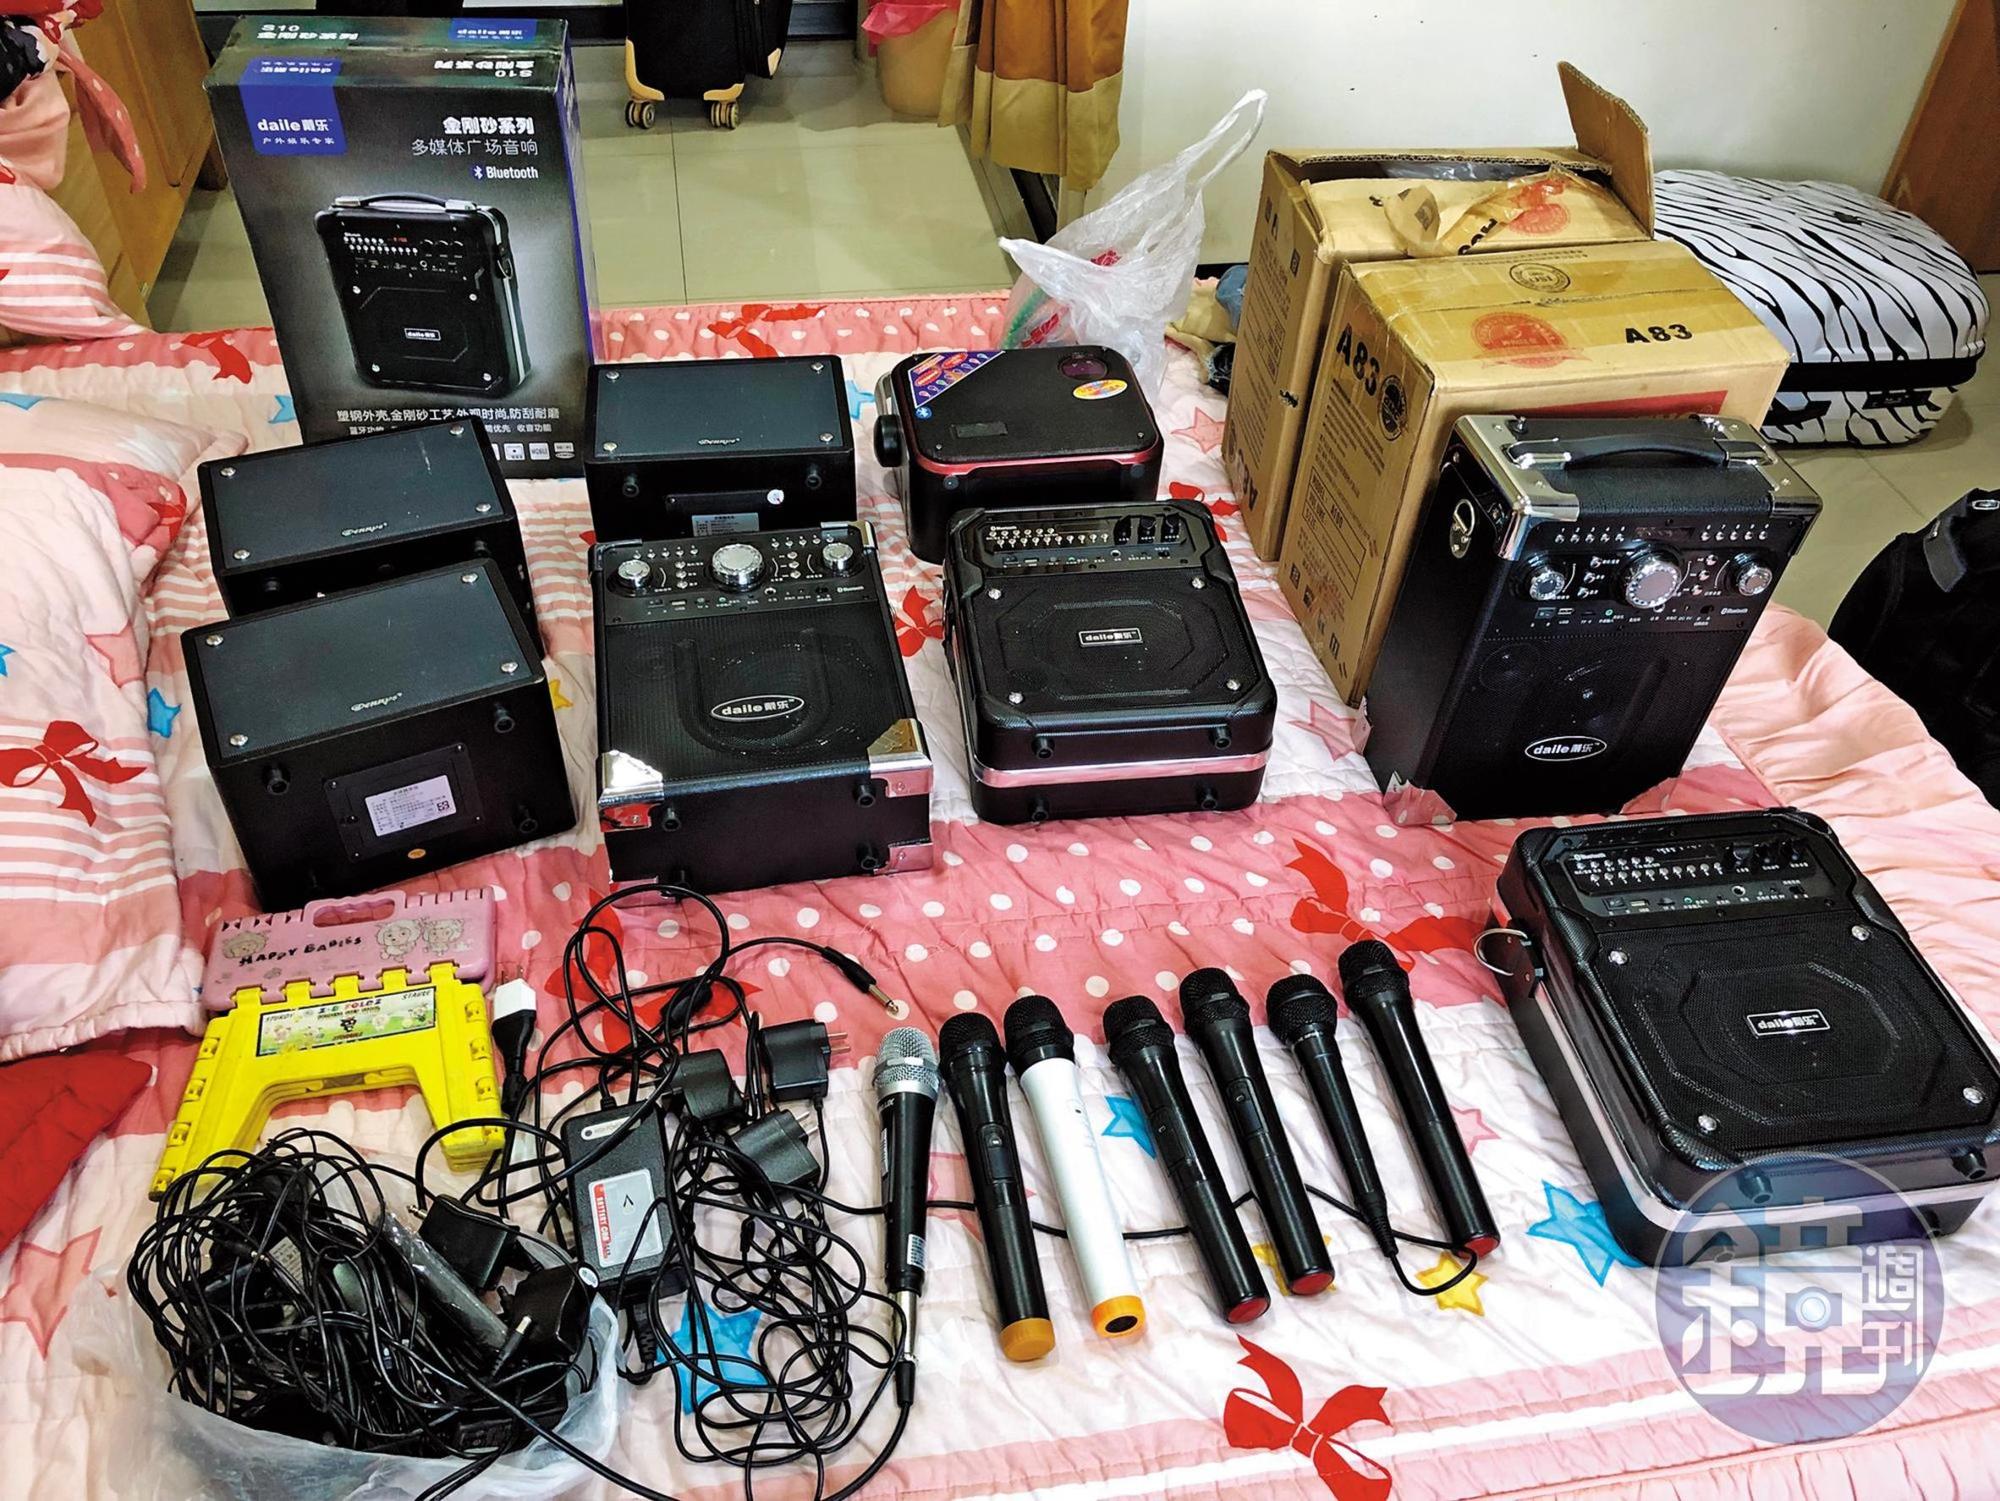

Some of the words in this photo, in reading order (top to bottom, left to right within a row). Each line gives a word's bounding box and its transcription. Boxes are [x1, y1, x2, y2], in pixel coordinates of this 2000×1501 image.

[442, 116, 535, 135] 金刚砂系列
[411, 138, 538, 156] 多媒体广场音响
[485, 166, 539, 179] Bluetooth
[1624, 324, 1693, 344] A83
[1336, 322, 1380, 396] A83
[239, 947, 299, 967] HAPPY
[303, 936, 361, 953] BABIES
